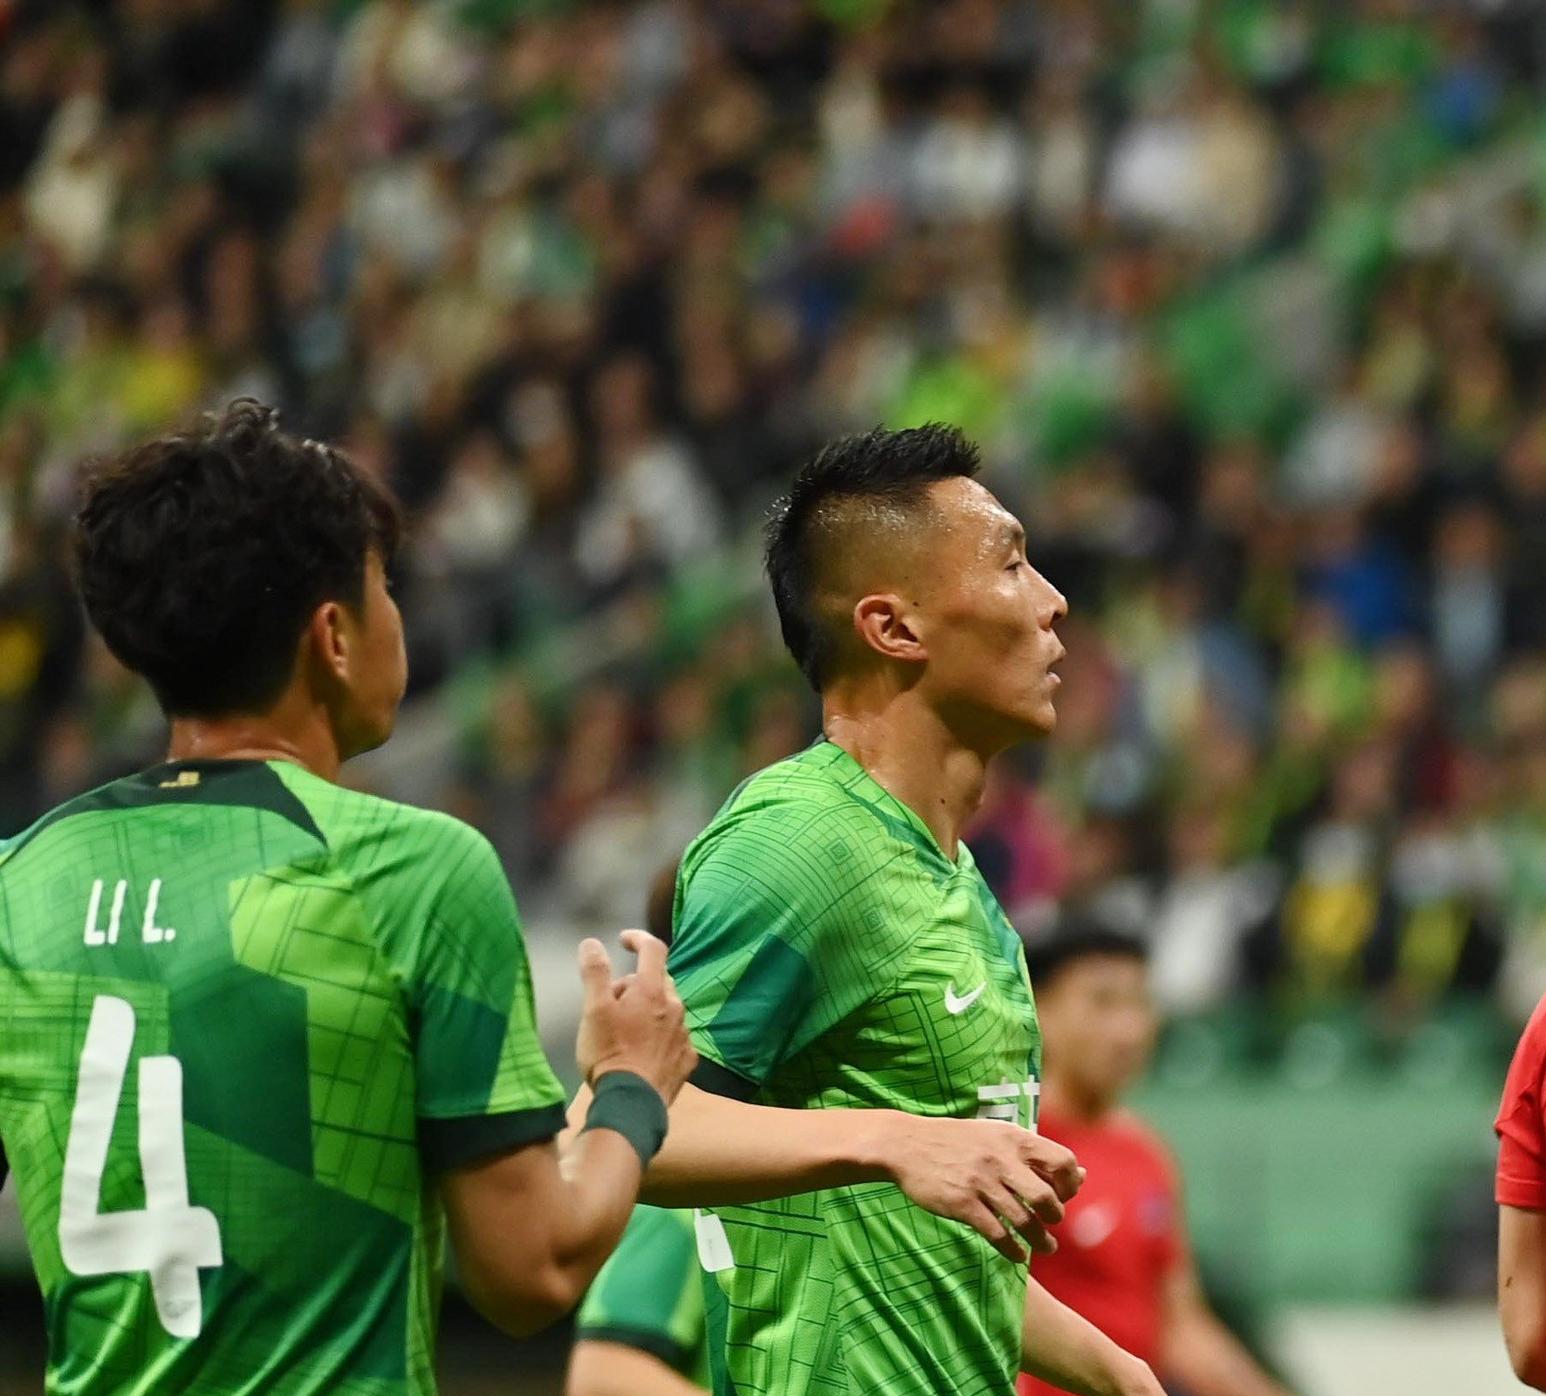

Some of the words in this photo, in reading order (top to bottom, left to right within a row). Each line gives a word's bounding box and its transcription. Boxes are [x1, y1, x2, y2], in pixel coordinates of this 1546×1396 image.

[84, 878, 127, 946] LI
[142, 878, 176, 944] L.
[59, 995, 223, 1339] 4
